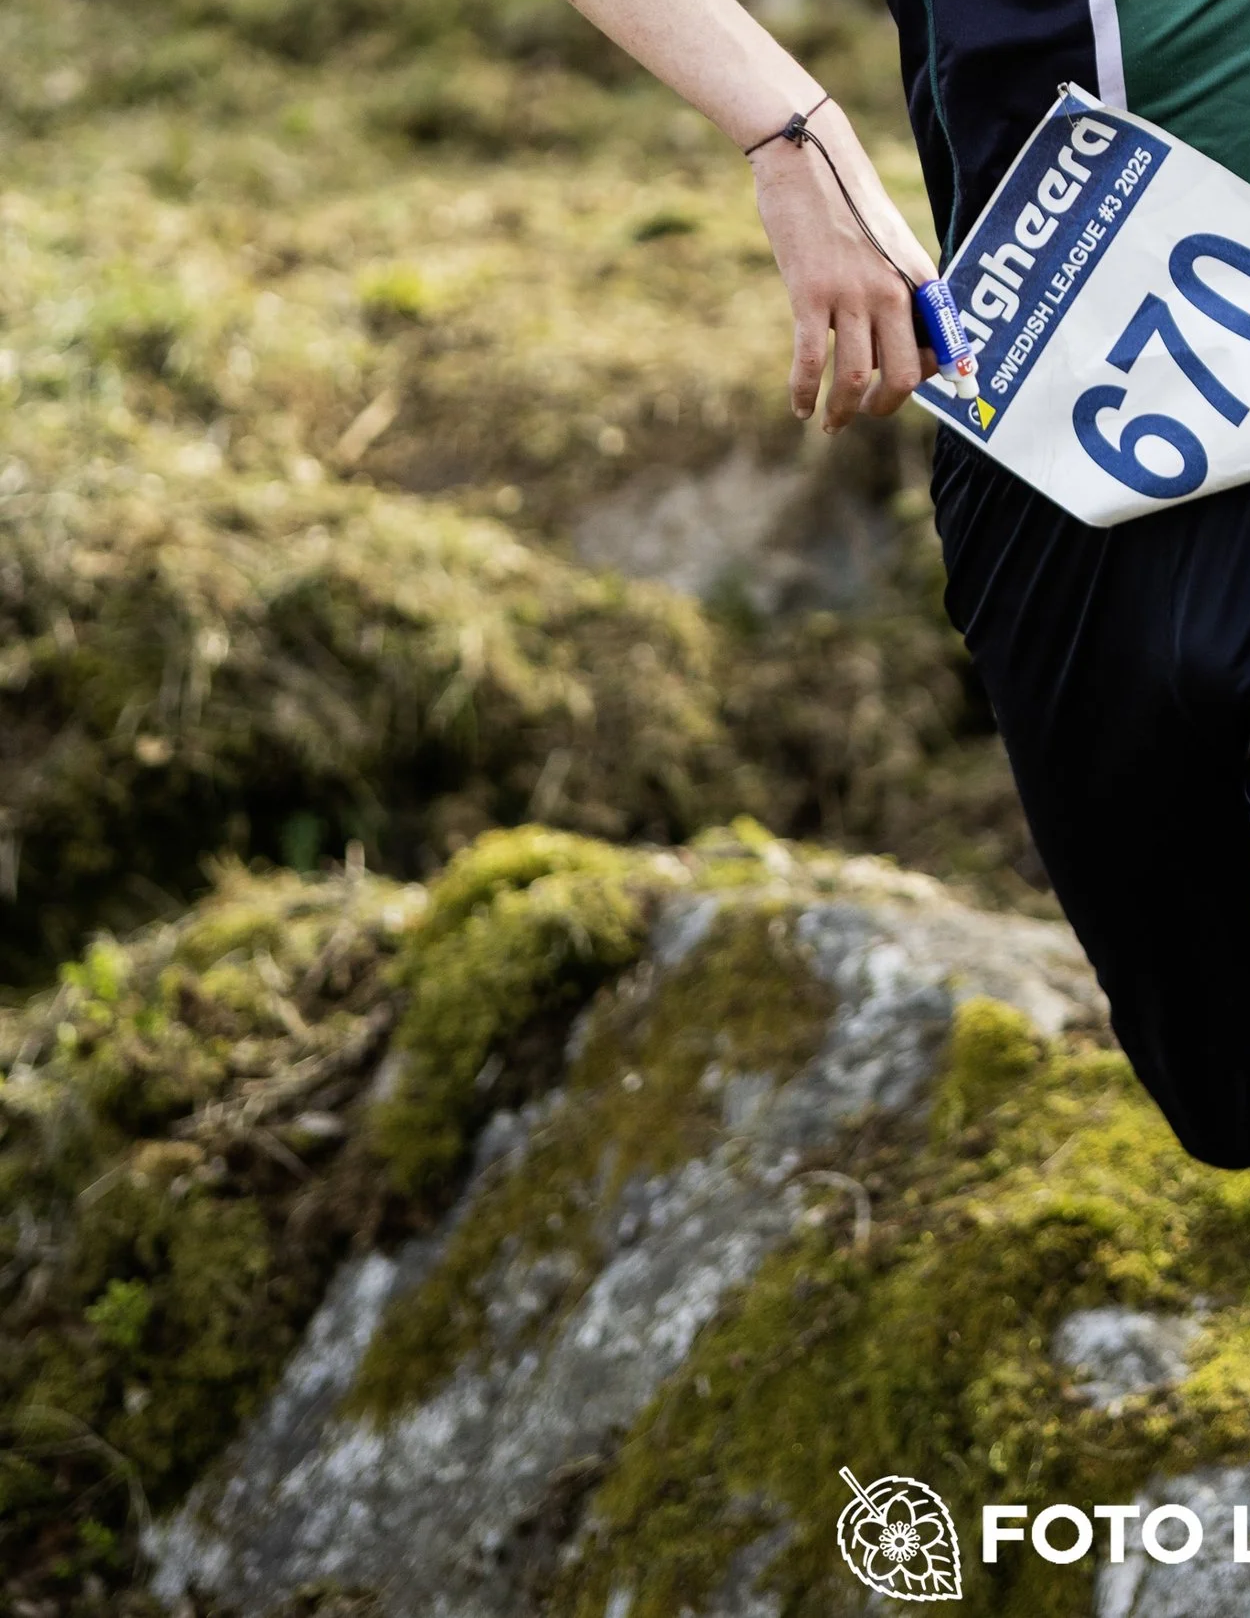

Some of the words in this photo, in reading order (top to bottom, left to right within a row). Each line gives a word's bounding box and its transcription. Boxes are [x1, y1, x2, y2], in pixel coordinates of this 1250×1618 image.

[990, 301, 1054, 394] SWEDISH
[1044, 219, 1107, 304] LEAGUE
[1098, 194, 1122, 223] #3
[1114, 147, 1152, 197] 2025
